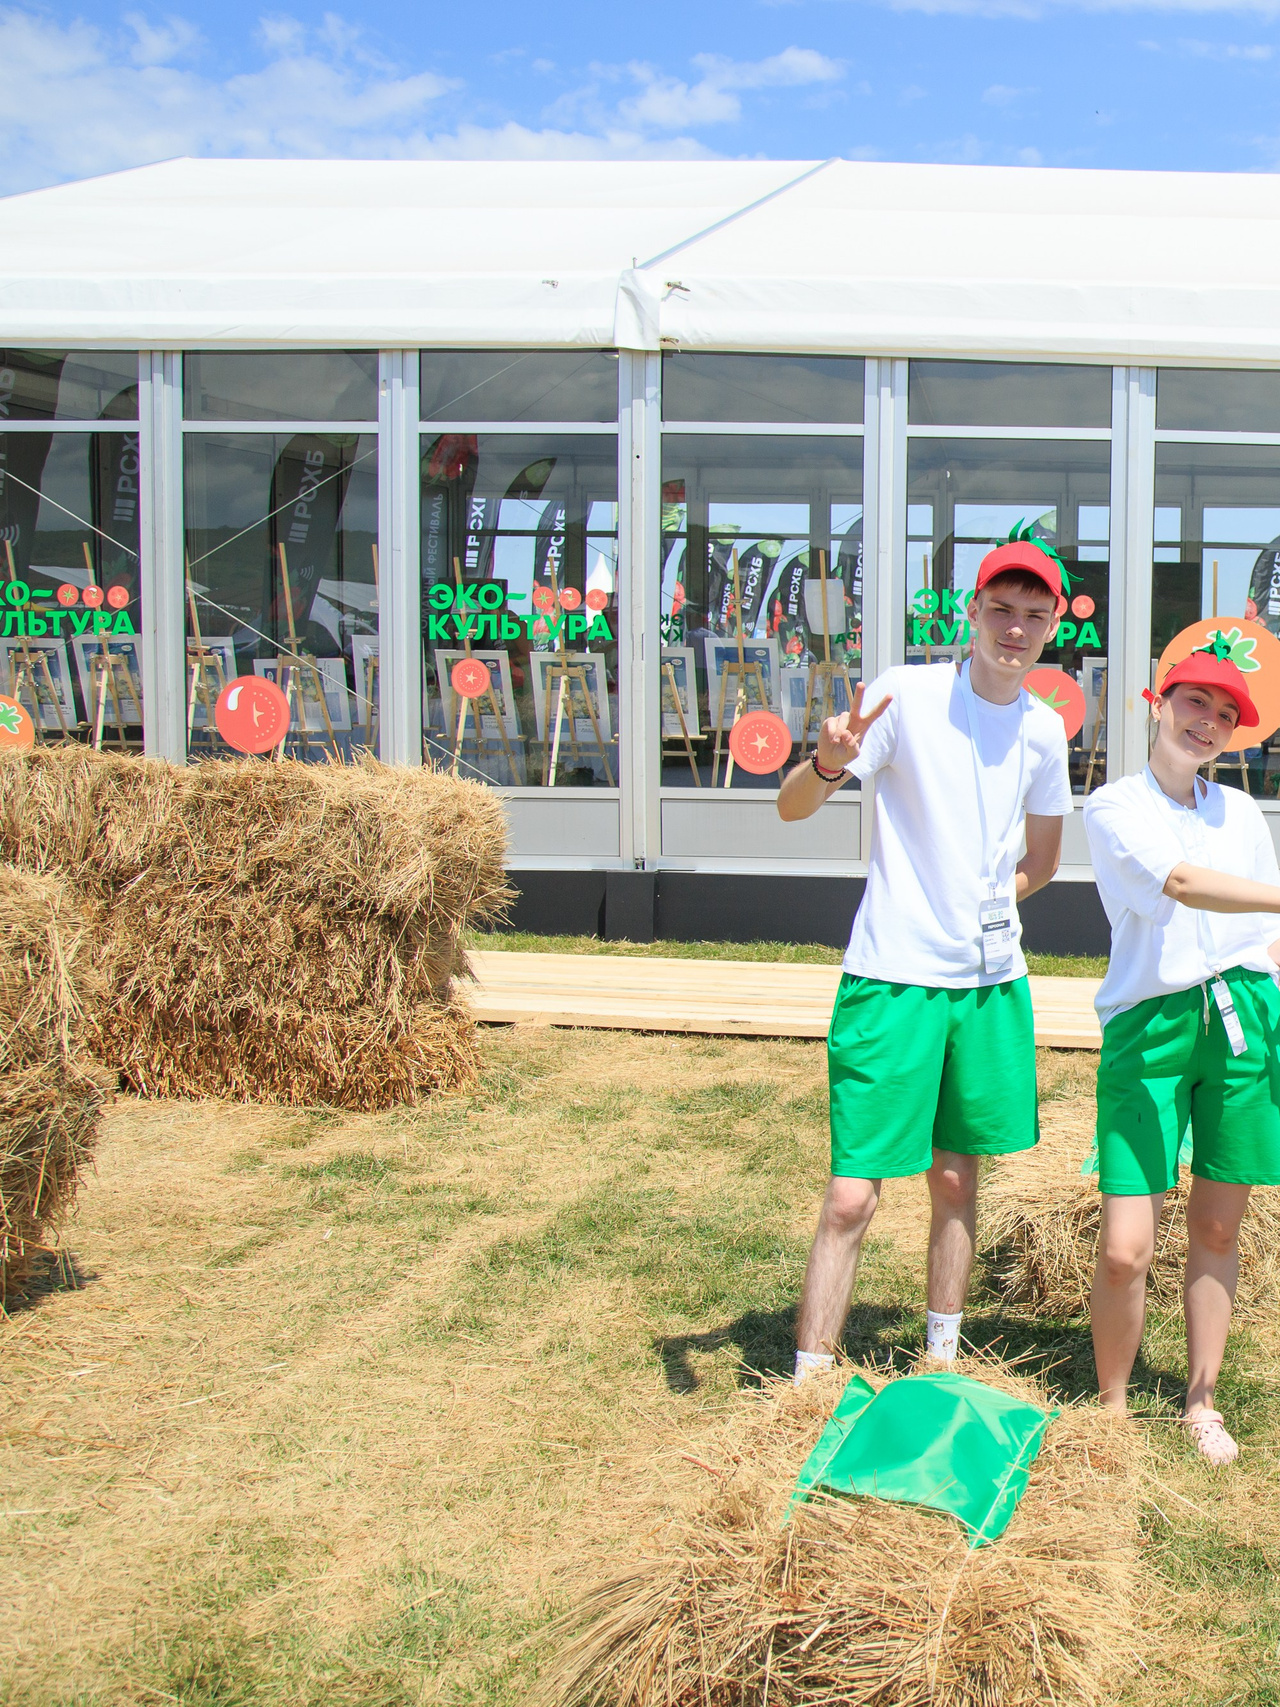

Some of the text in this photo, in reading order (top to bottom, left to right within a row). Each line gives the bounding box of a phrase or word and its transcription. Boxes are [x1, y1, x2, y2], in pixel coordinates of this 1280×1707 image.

[294, 450, 324, 519] РСХБ
[744, 556, 764, 598] РСХБ
[788, 567, 804, 602] РСХБ
[428, 614, 614, 641] КУЛЬТУРА
